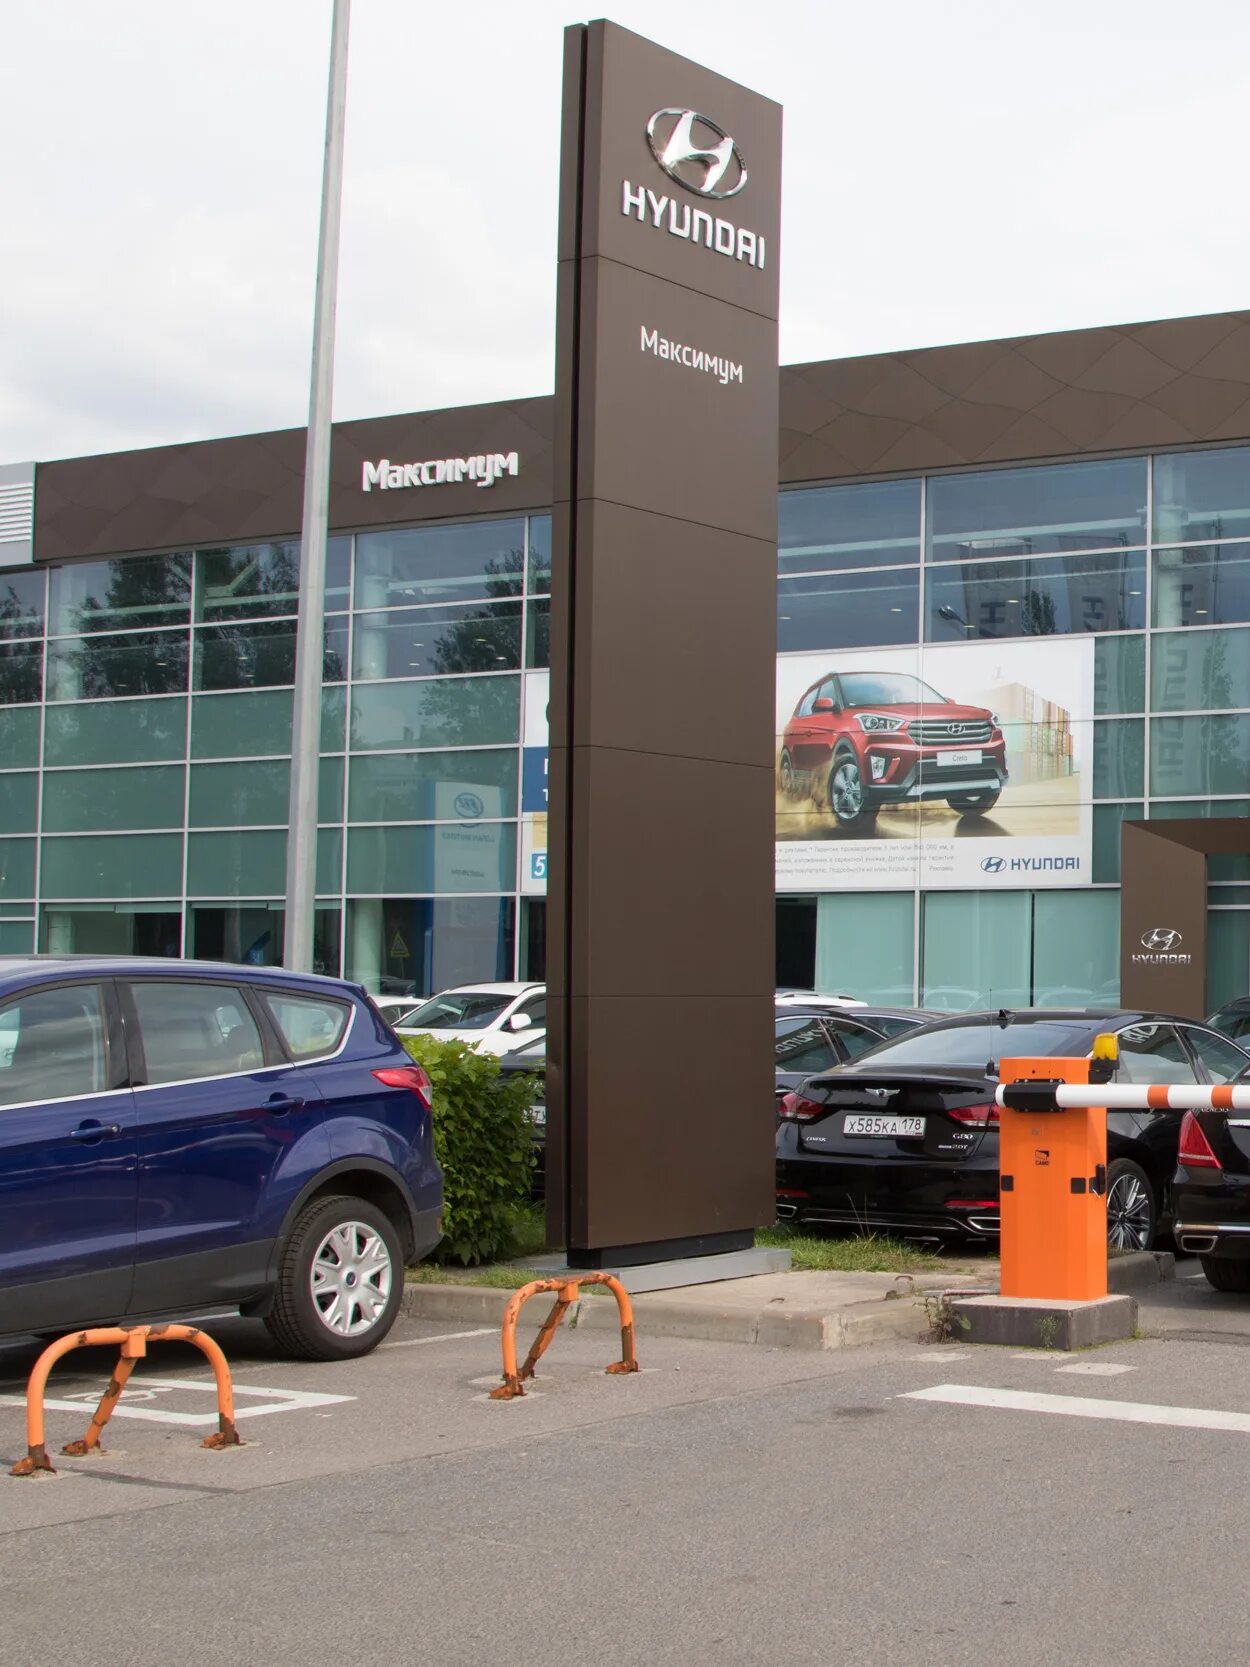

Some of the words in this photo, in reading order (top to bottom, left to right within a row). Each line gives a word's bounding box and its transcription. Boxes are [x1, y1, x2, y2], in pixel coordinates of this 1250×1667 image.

[621, 180, 766, 270] HYUNDAI
[640, 326, 744, 385] Максимум
[362, 451, 519, 492] Максимум
[1010, 855, 1080, 871] HYUNDAI
[1131, 953, 1191, 965] HYUNDAI
[902, 1118, 922, 1130] 178
